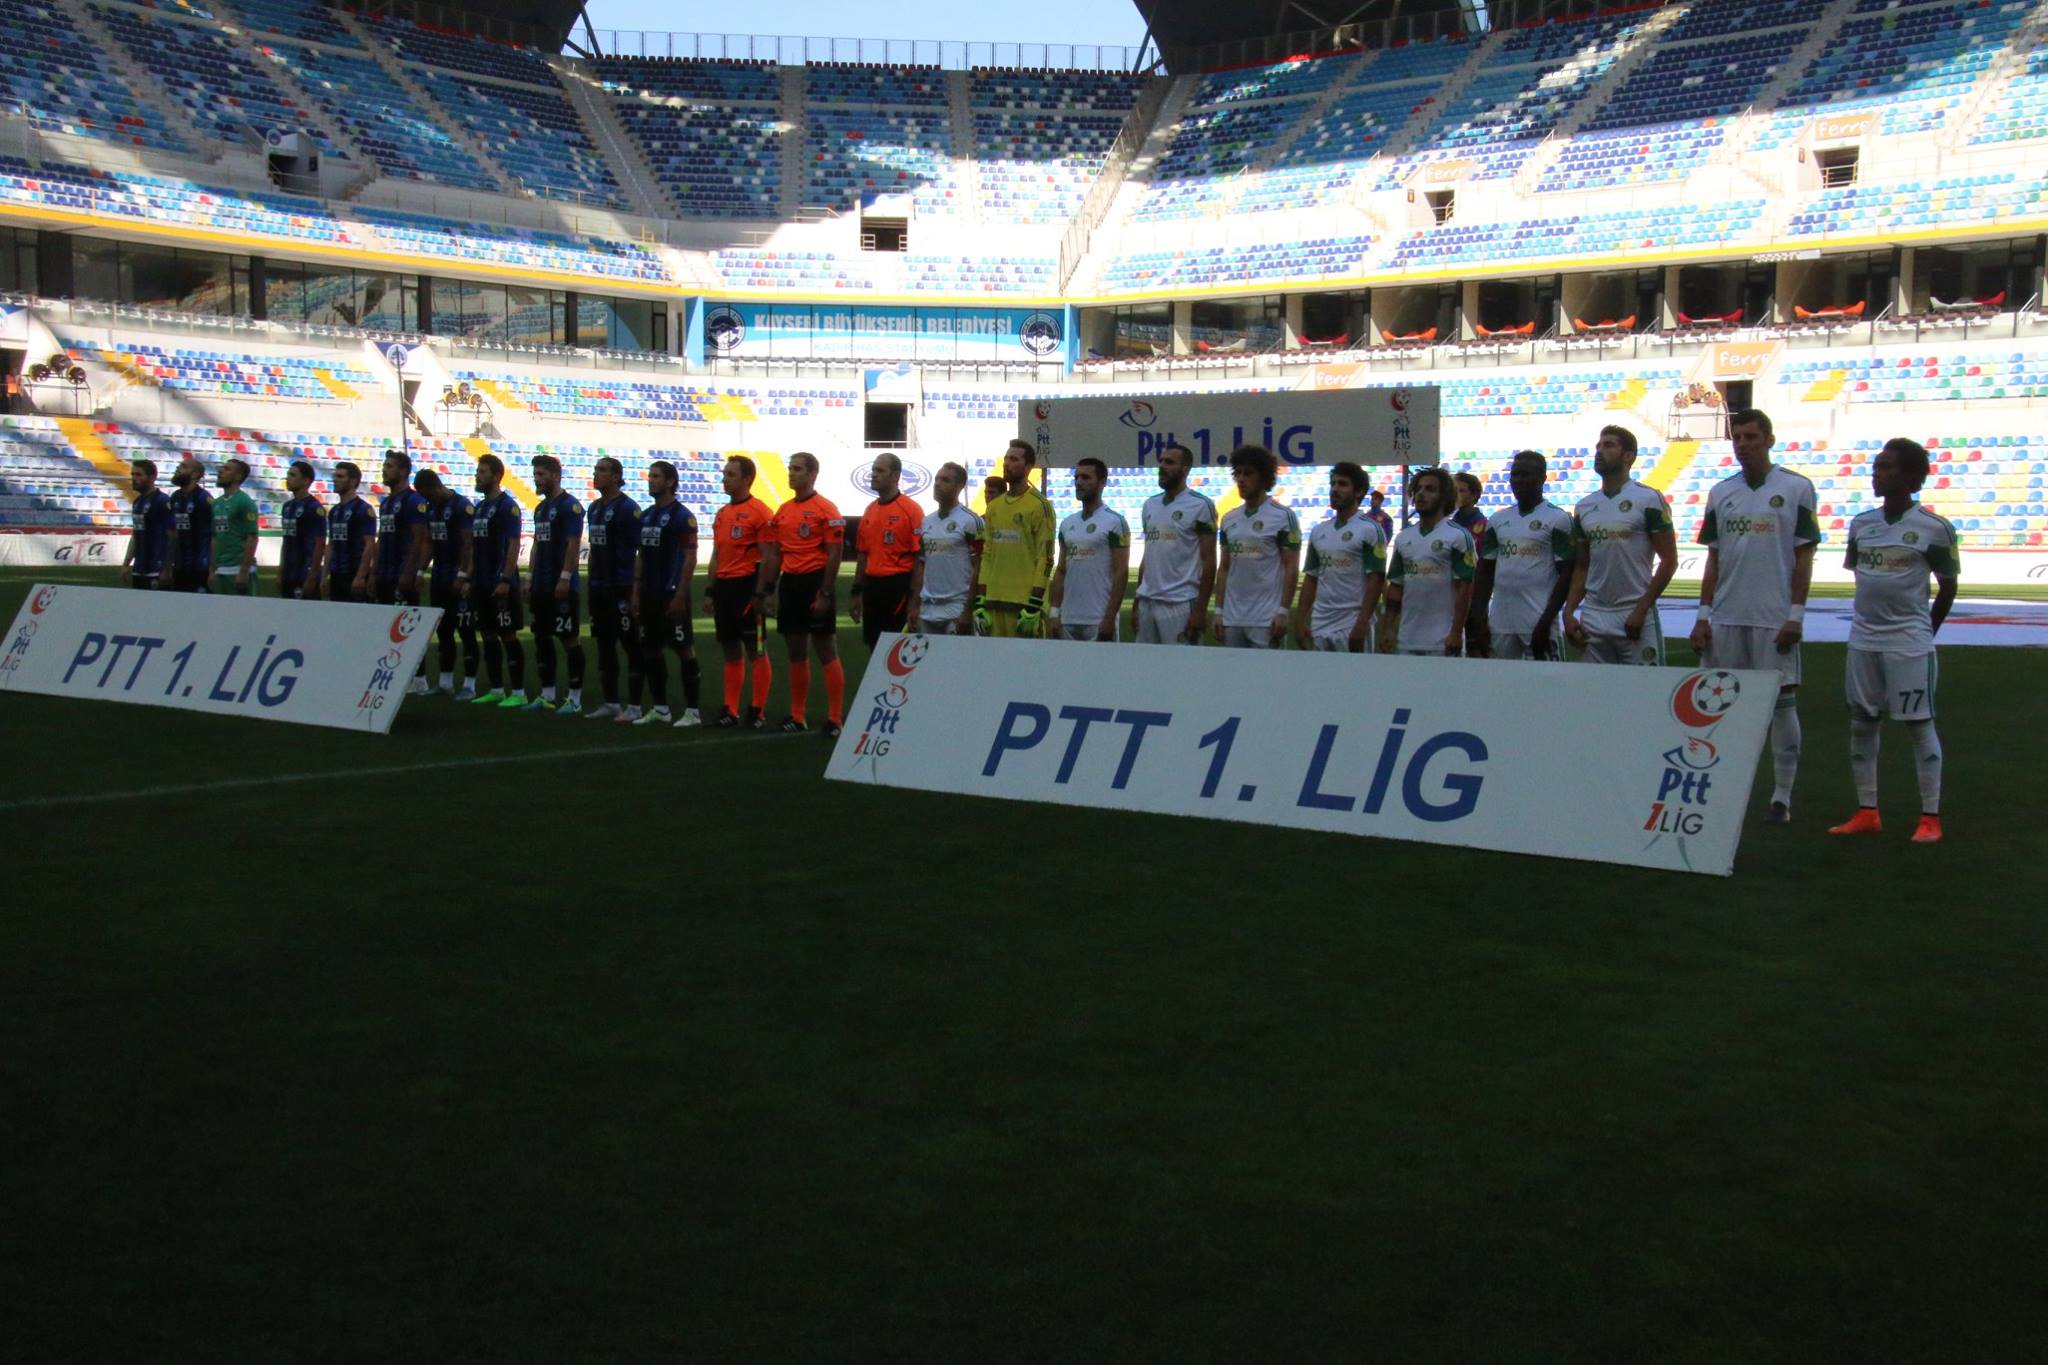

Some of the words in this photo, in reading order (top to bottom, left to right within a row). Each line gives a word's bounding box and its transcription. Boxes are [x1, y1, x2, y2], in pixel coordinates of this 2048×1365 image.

[754, 313, 820, 329] KAYSERİ
[823, 313, 922, 334] BÜYÜKŞEHİR
[926, 315, 1012, 335] BELEDİYESİ
[457, 612, 472, 628] 77
[497, 612, 512, 628] 15
[555, 616, 573, 632] 24
[621, 616, 631, 632] 9
[674, 625, 685, 641] 5
[61, 632, 166, 691] PTT
[164, 641, 197, 698] 1.
[207, 634, 305, 708] LİG
[367, 668, 394, 690] Ptt
[1899, 689, 1925, 714] 77
[865, 706, 900, 734] Ptt
[981, 701, 1173, 790] PTT
[1198, 716, 1257, 802] 1.
[1296, 707, 1489, 823] LİG
[1656, 767, 1713, 806] Ptt
